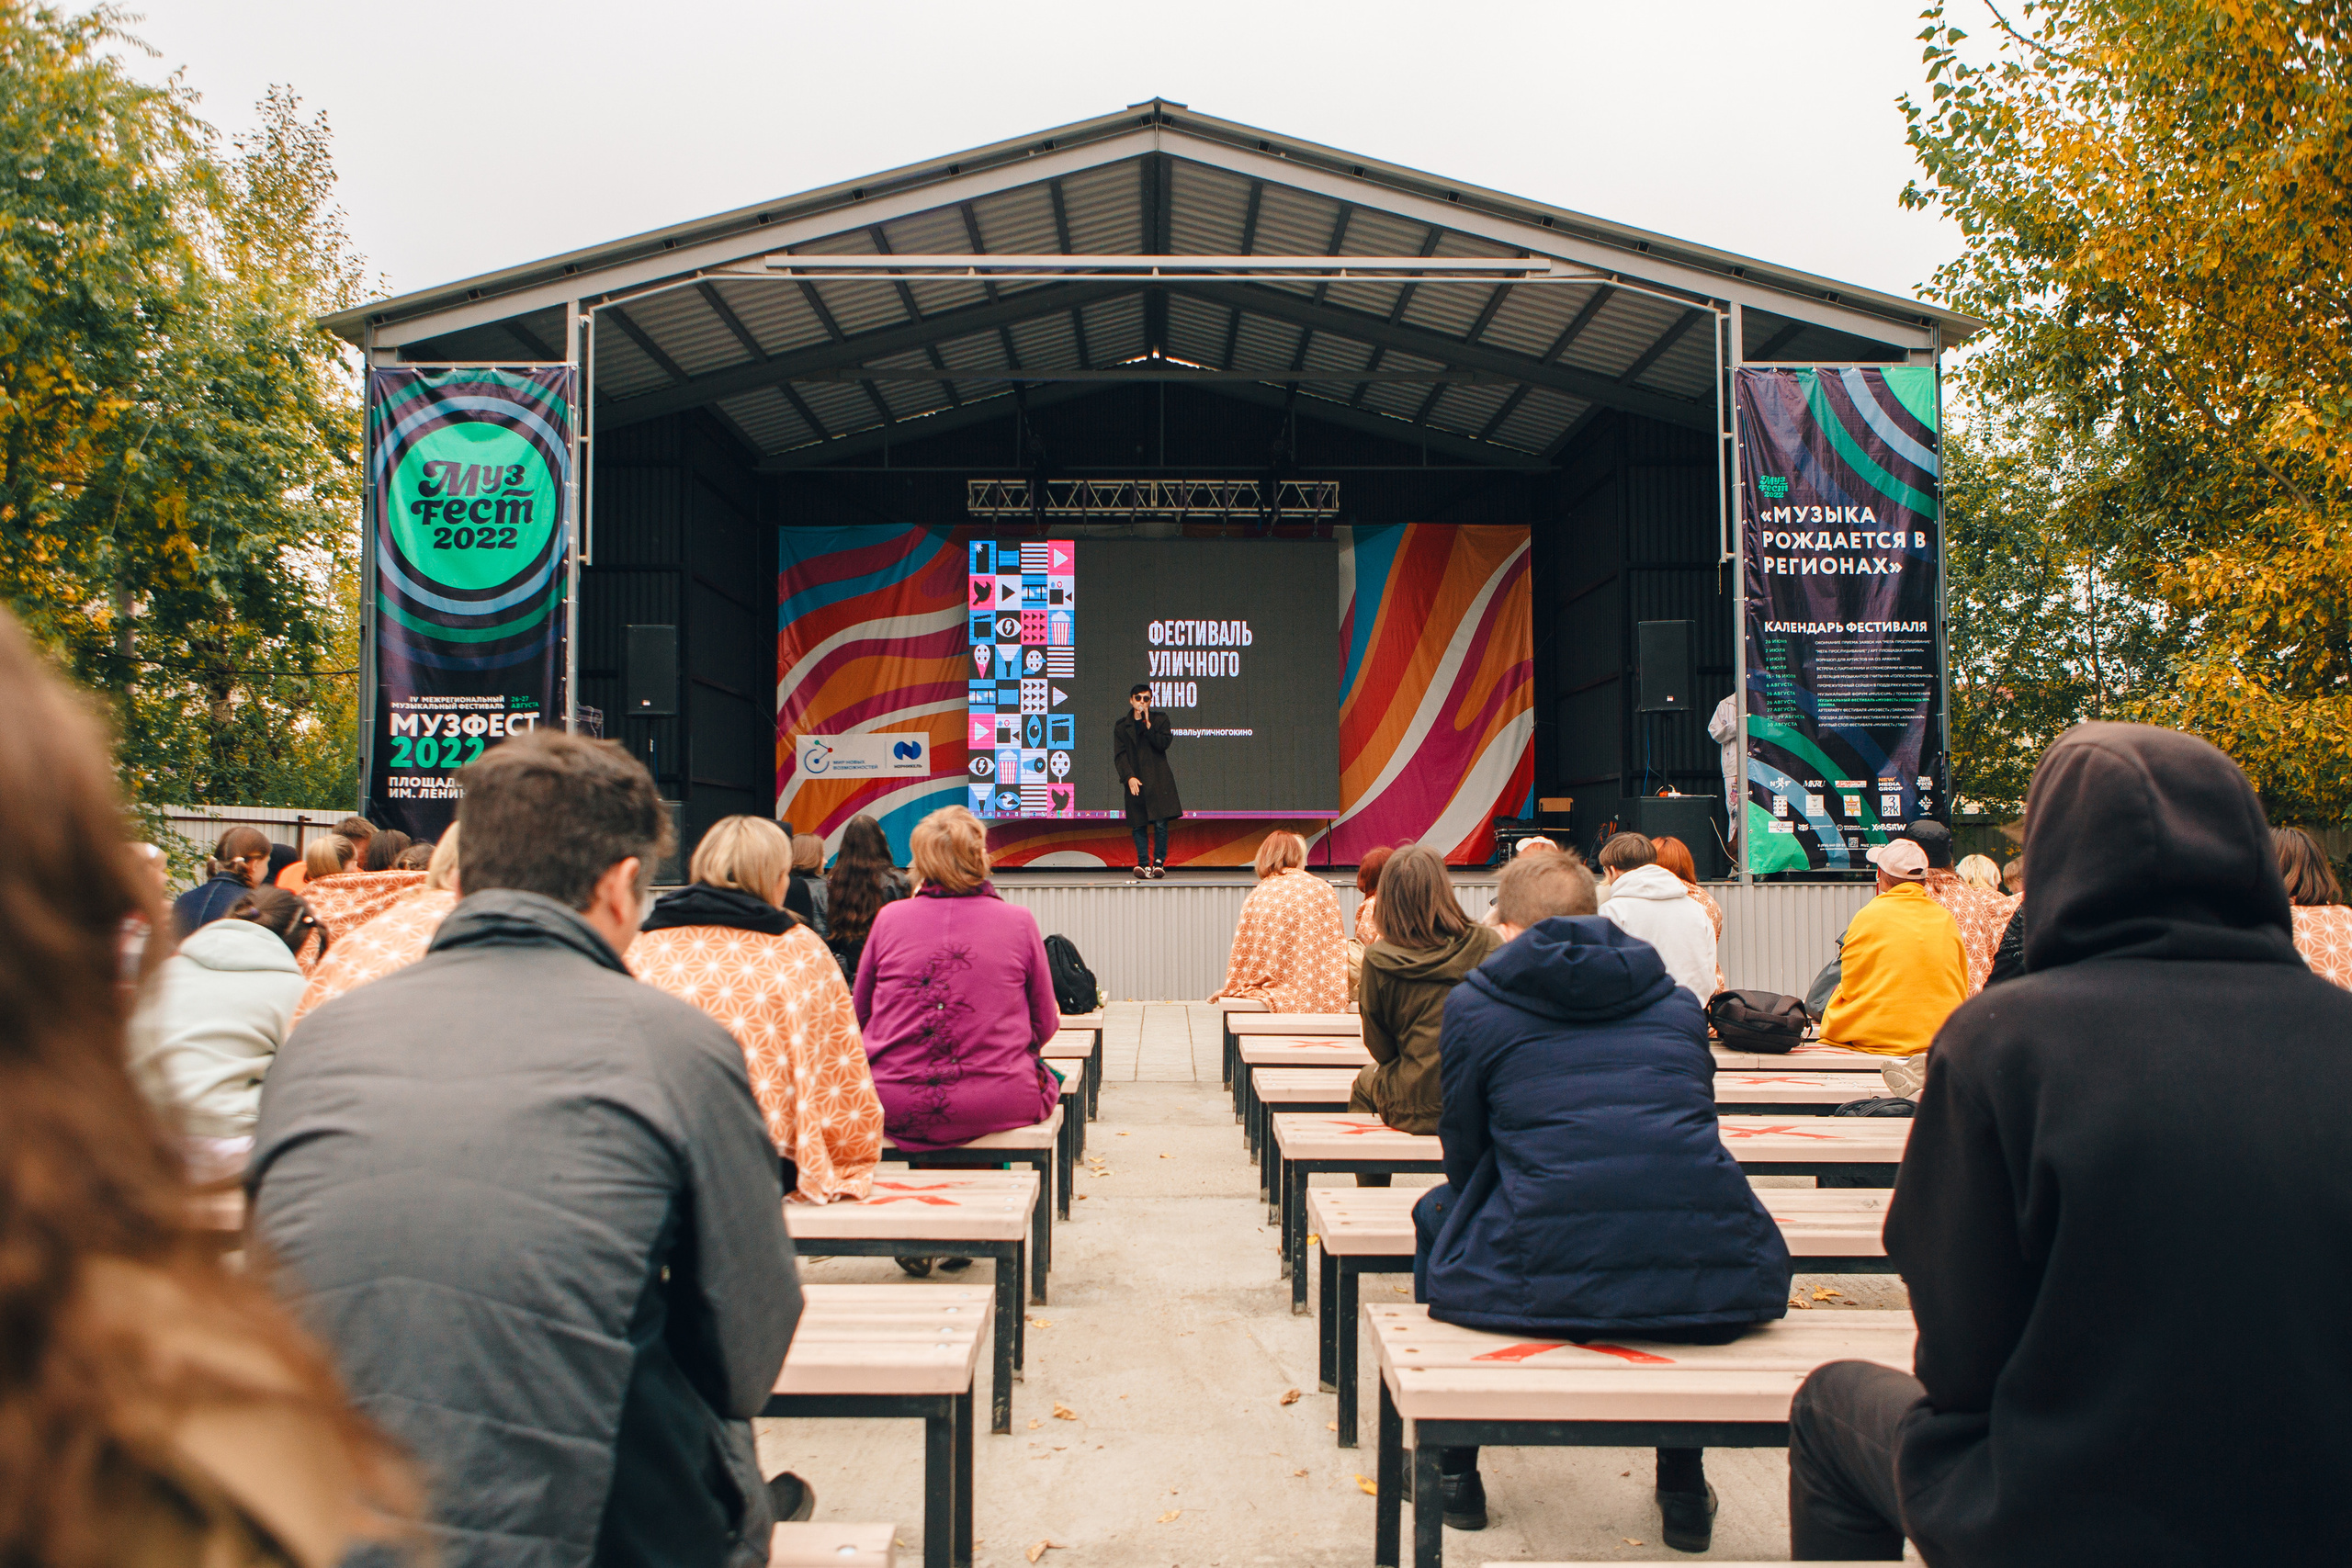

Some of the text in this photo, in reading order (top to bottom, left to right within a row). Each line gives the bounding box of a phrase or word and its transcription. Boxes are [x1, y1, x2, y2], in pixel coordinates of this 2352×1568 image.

[418, 460, 534, 497] Муз
[1760, 506, 1876, 524] «МУЗЫКА
[434, 527, 517, 549] 2022
[1762, 531, 1927, 551] РОЖДАЕТСЯ В
[1763, 557, 1903, 575] РЕГИОНАХ»
[1148, 620, 1252, 646] ФЕСТИВАЛЬ
[1764, 621, 1928, 635] КАЛЕНДАРЬ ФЕСТИВАЛЯ
[1148, 651, 1239, 677] УЛИЧНОГО
[422, 694, 504, 703] МЕЖРЕГИОНАЛЬНЫЙ
[1149, 682, 1197, 707] КИНО
[390, 702, 458, 710] МУЗЫКАЛЬНЫЙ
[511, 701, 539, 709] АВГУСТА
[390, 712, 540, 737] МУЗФЕСТ
[1170, 728, 1252, 738] тивальуличногокино
[390, 736, 485, 768] 2022
[388, 788, 467, 798] ИМ. ЛЕНИН
